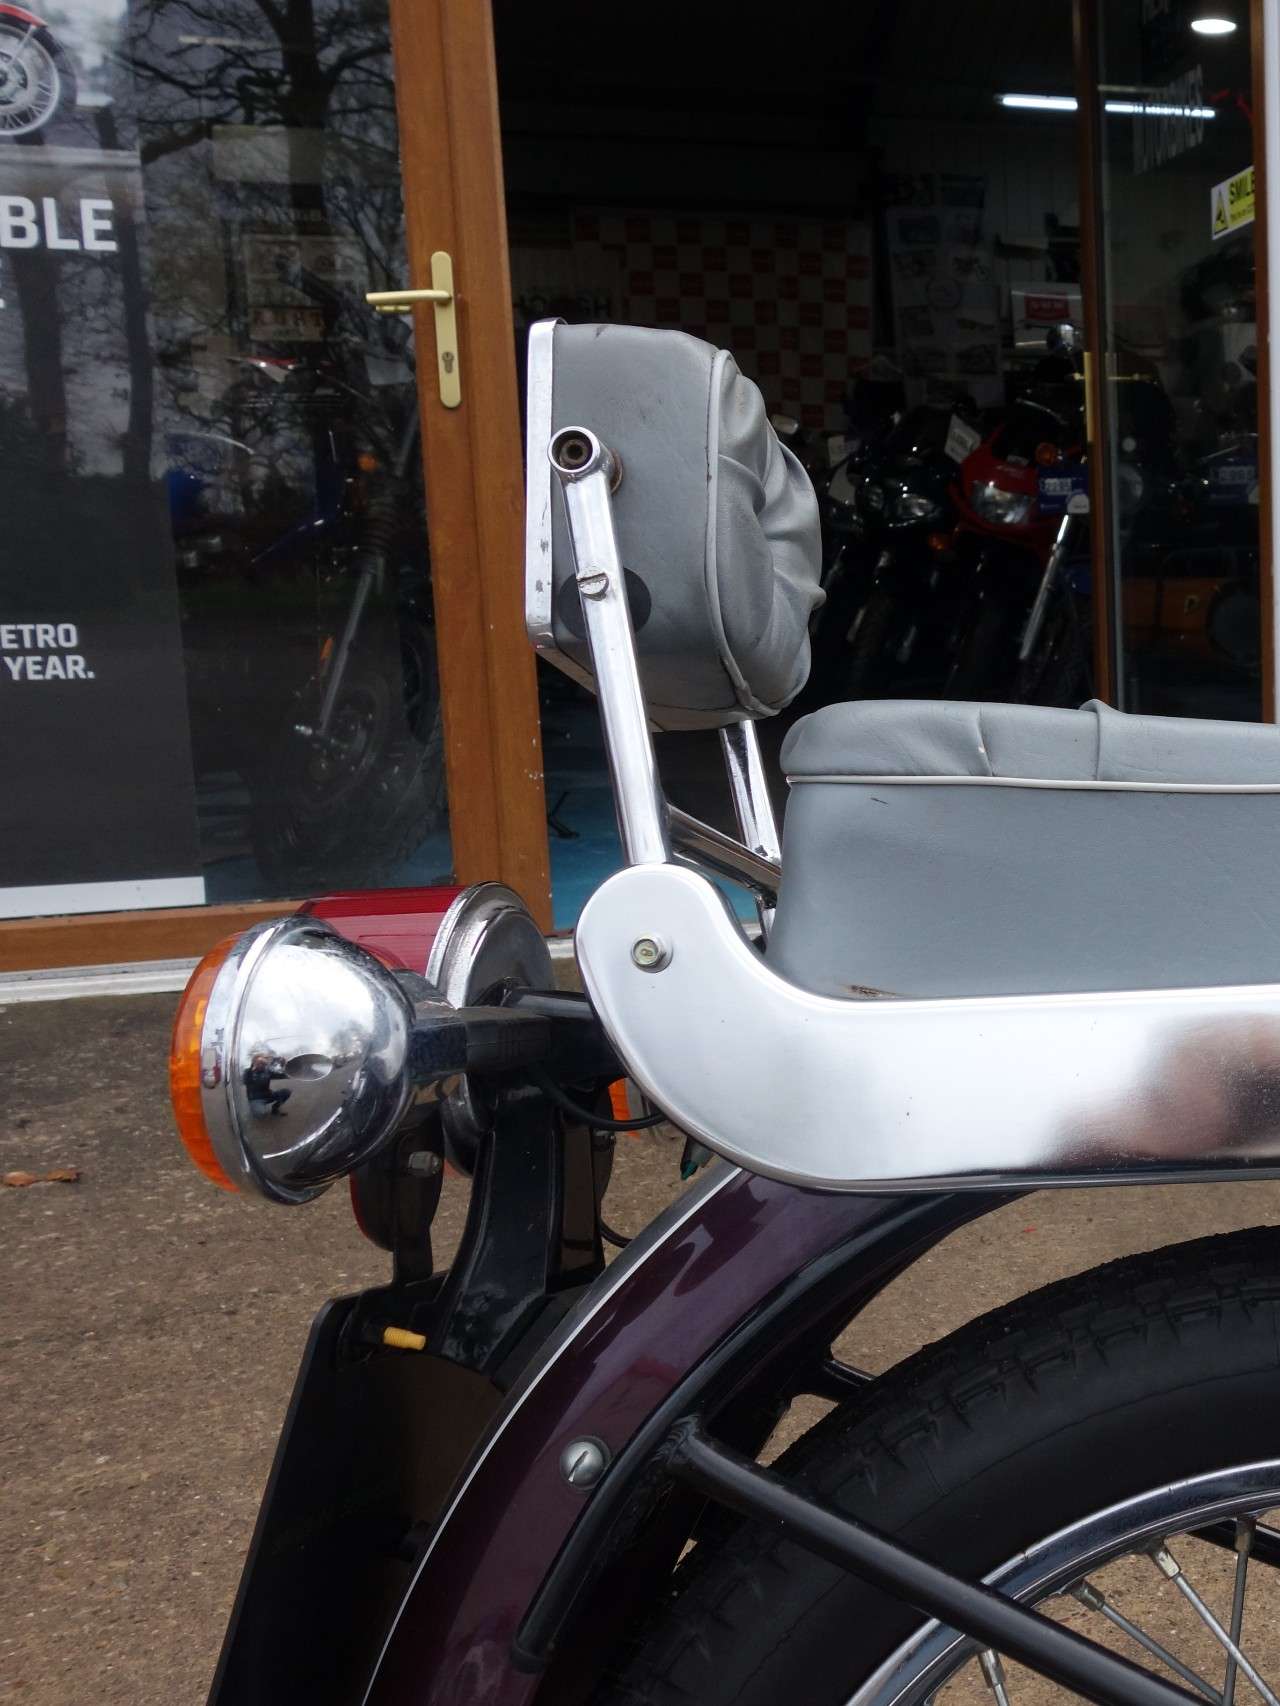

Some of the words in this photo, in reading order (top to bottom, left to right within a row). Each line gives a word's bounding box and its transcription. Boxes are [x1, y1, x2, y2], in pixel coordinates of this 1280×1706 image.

[0, 195, 118, 252] BLE
[0, 623, 78, 649] ETRO
[3, 655, 96, 681] YEAR.
